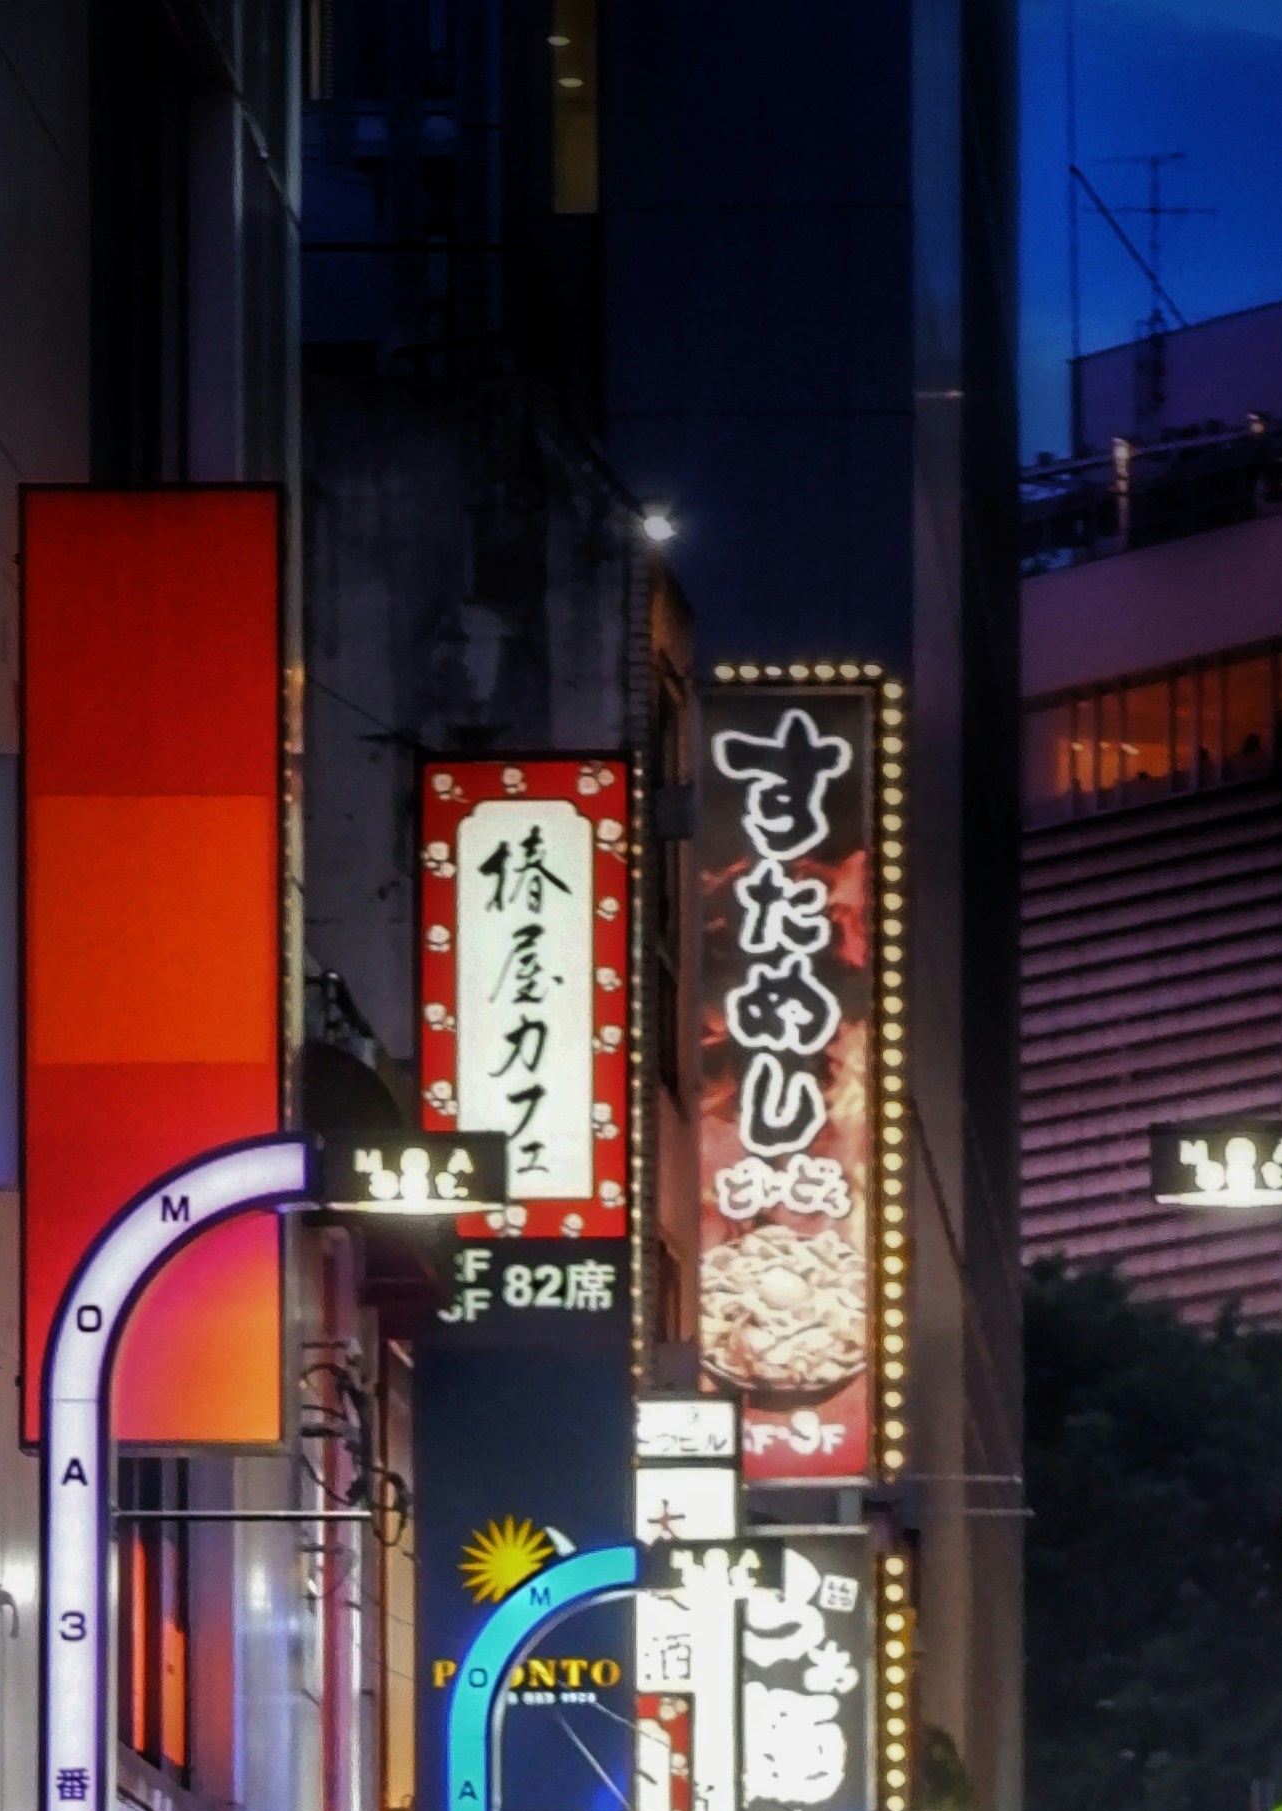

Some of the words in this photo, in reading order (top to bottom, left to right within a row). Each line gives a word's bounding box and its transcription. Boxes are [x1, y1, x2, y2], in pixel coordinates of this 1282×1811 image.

[478, 824, 571, 1176] 椿屋カフェ
[503, 1260, 616, 1311] 82席
